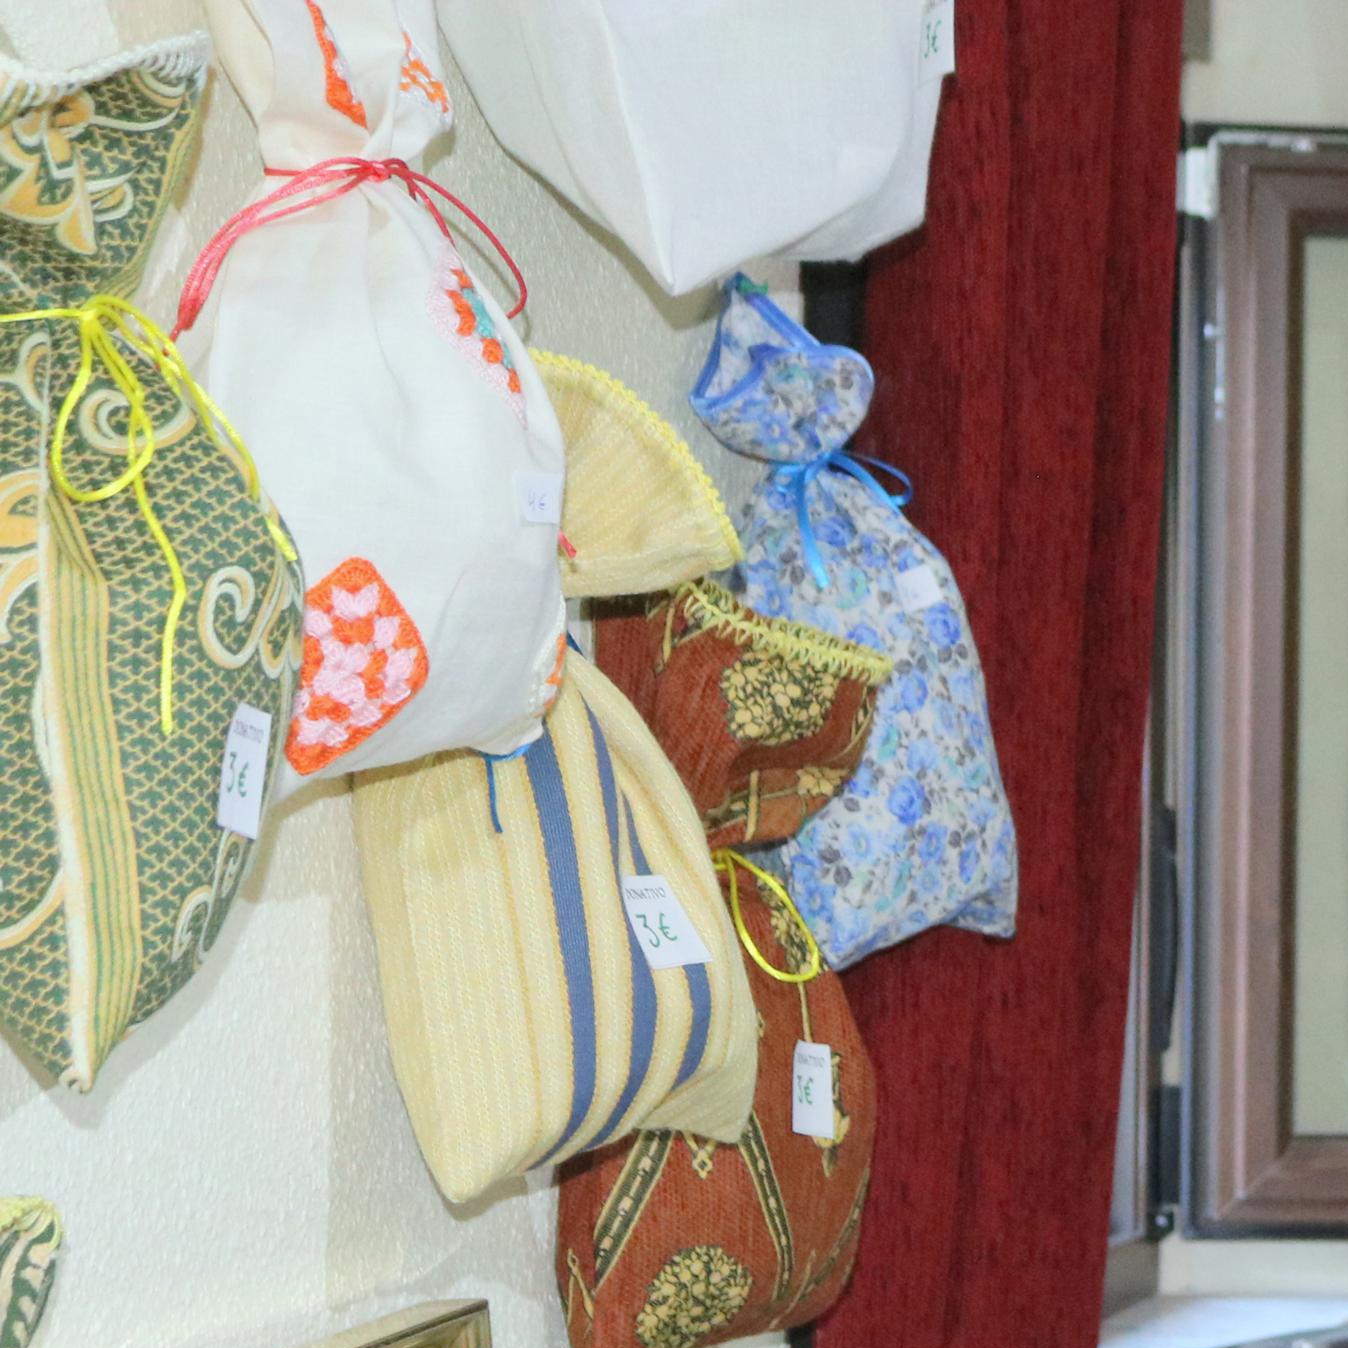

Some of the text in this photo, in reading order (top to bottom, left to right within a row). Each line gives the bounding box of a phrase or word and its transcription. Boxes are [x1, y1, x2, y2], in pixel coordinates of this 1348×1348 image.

[226, 750, 249, 798] 3€
[635, 912, 678, 948] 3€
[797, 1074, 814, 1105] 3€
